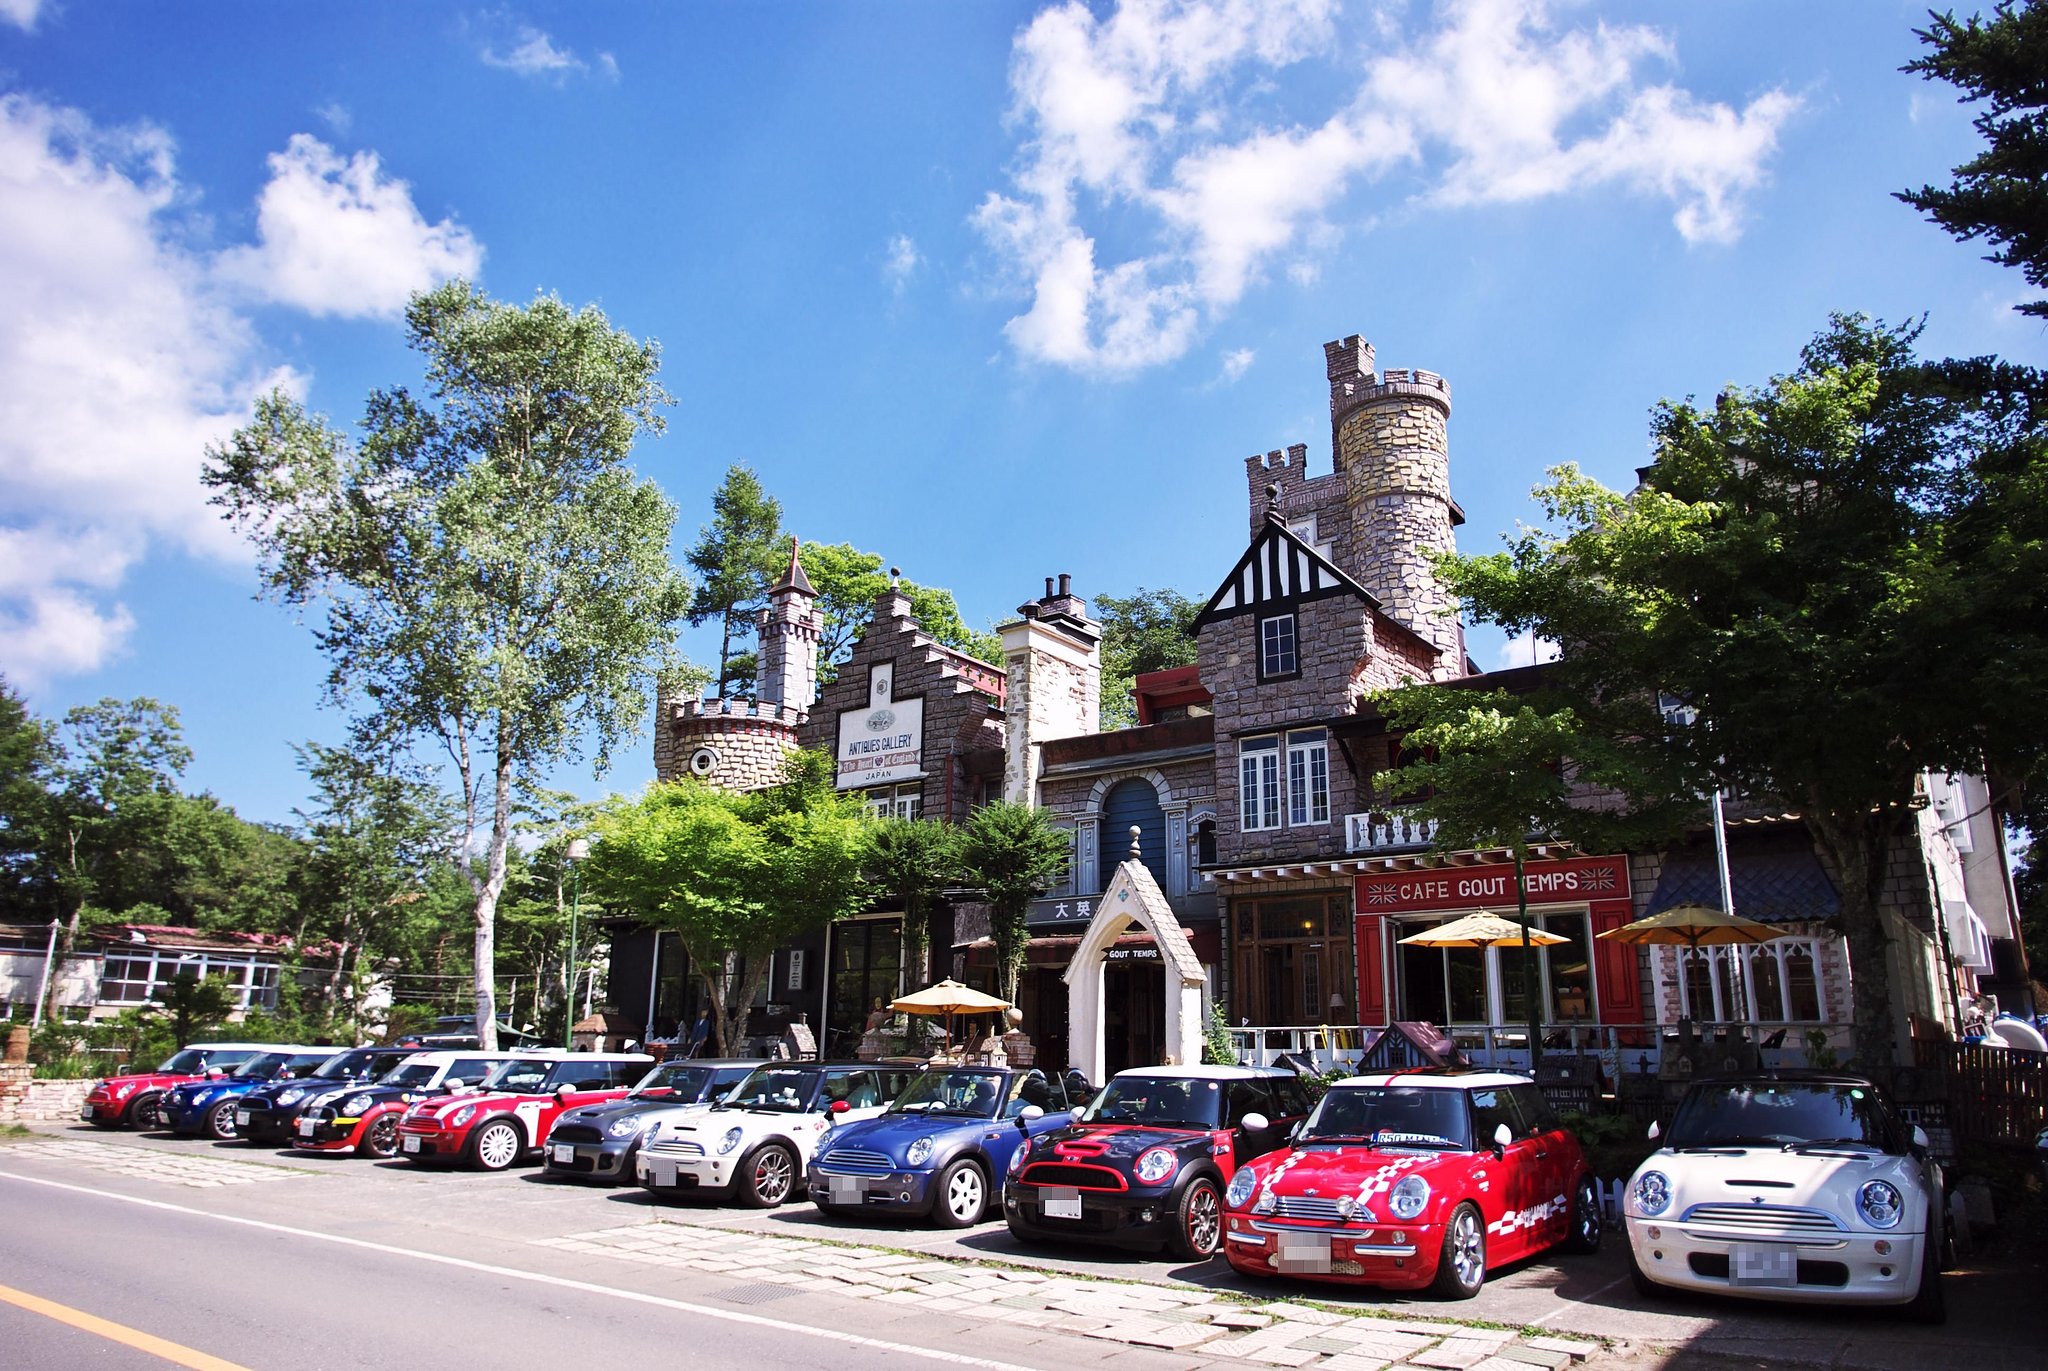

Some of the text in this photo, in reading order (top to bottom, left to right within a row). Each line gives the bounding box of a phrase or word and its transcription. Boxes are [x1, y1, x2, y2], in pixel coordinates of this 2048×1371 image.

[849, 733, 913, 756] ANTIQUES GALLERY
[866, 771, 892, 780] JAPAN
[1400, 881, 1449, 900] CAFE
[1458, 876, 1506, 898] GOUT
[1055, 900, 1091, 919] 大英
[1109, 949, 1158, 959] GOUT TEMPS
